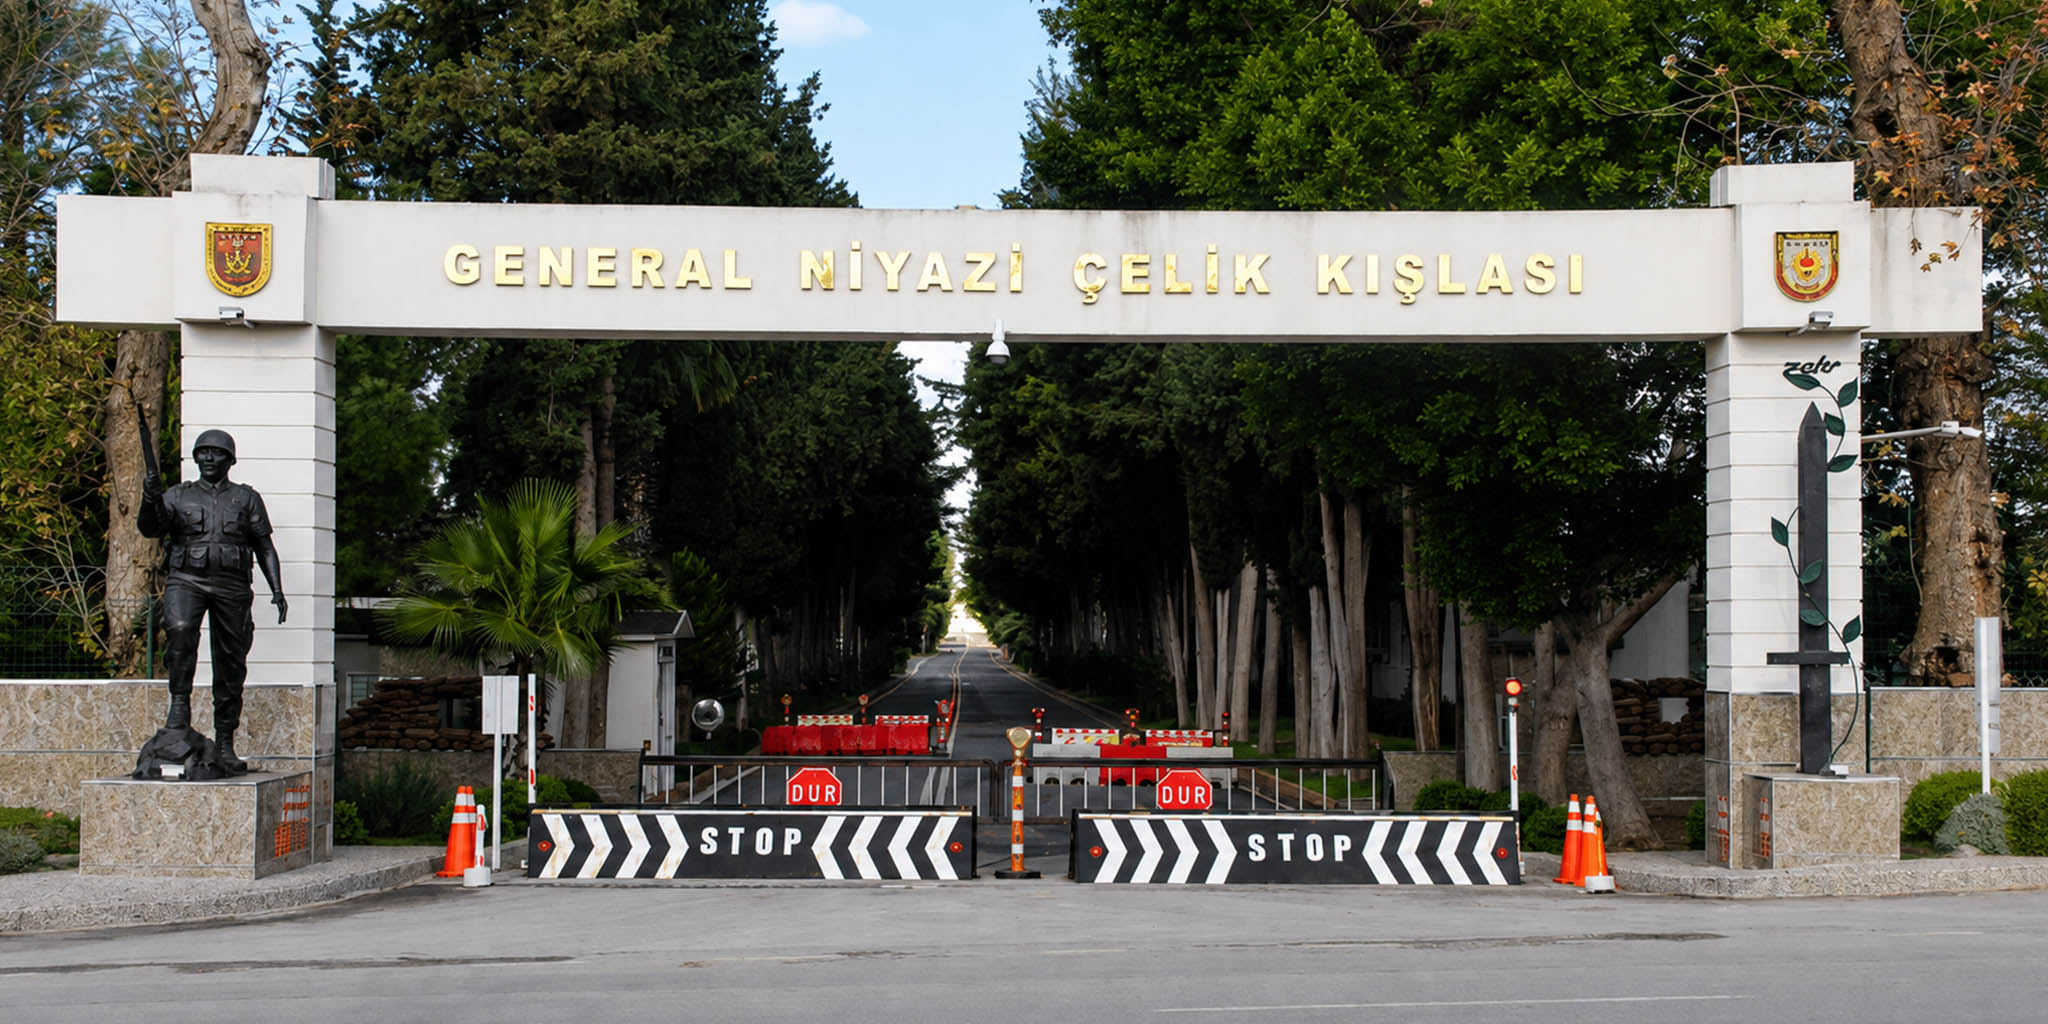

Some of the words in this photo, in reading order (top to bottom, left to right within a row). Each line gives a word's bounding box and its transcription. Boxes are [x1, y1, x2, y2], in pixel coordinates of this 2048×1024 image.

[443, 244, 753, 290] GENERAL
[800, 240, 1023, 294] NİYAZİ
[1072, 243, 1272, 304] ÇELİK
[1316, 253, 1584, 305] KIŞLASI
[792, 784, 836, 802] DUR
[1162, 786, 1206, 804] DUR
[700, 827, 802, 856] STOP
[1248, 833, 1351, 862] STOP
